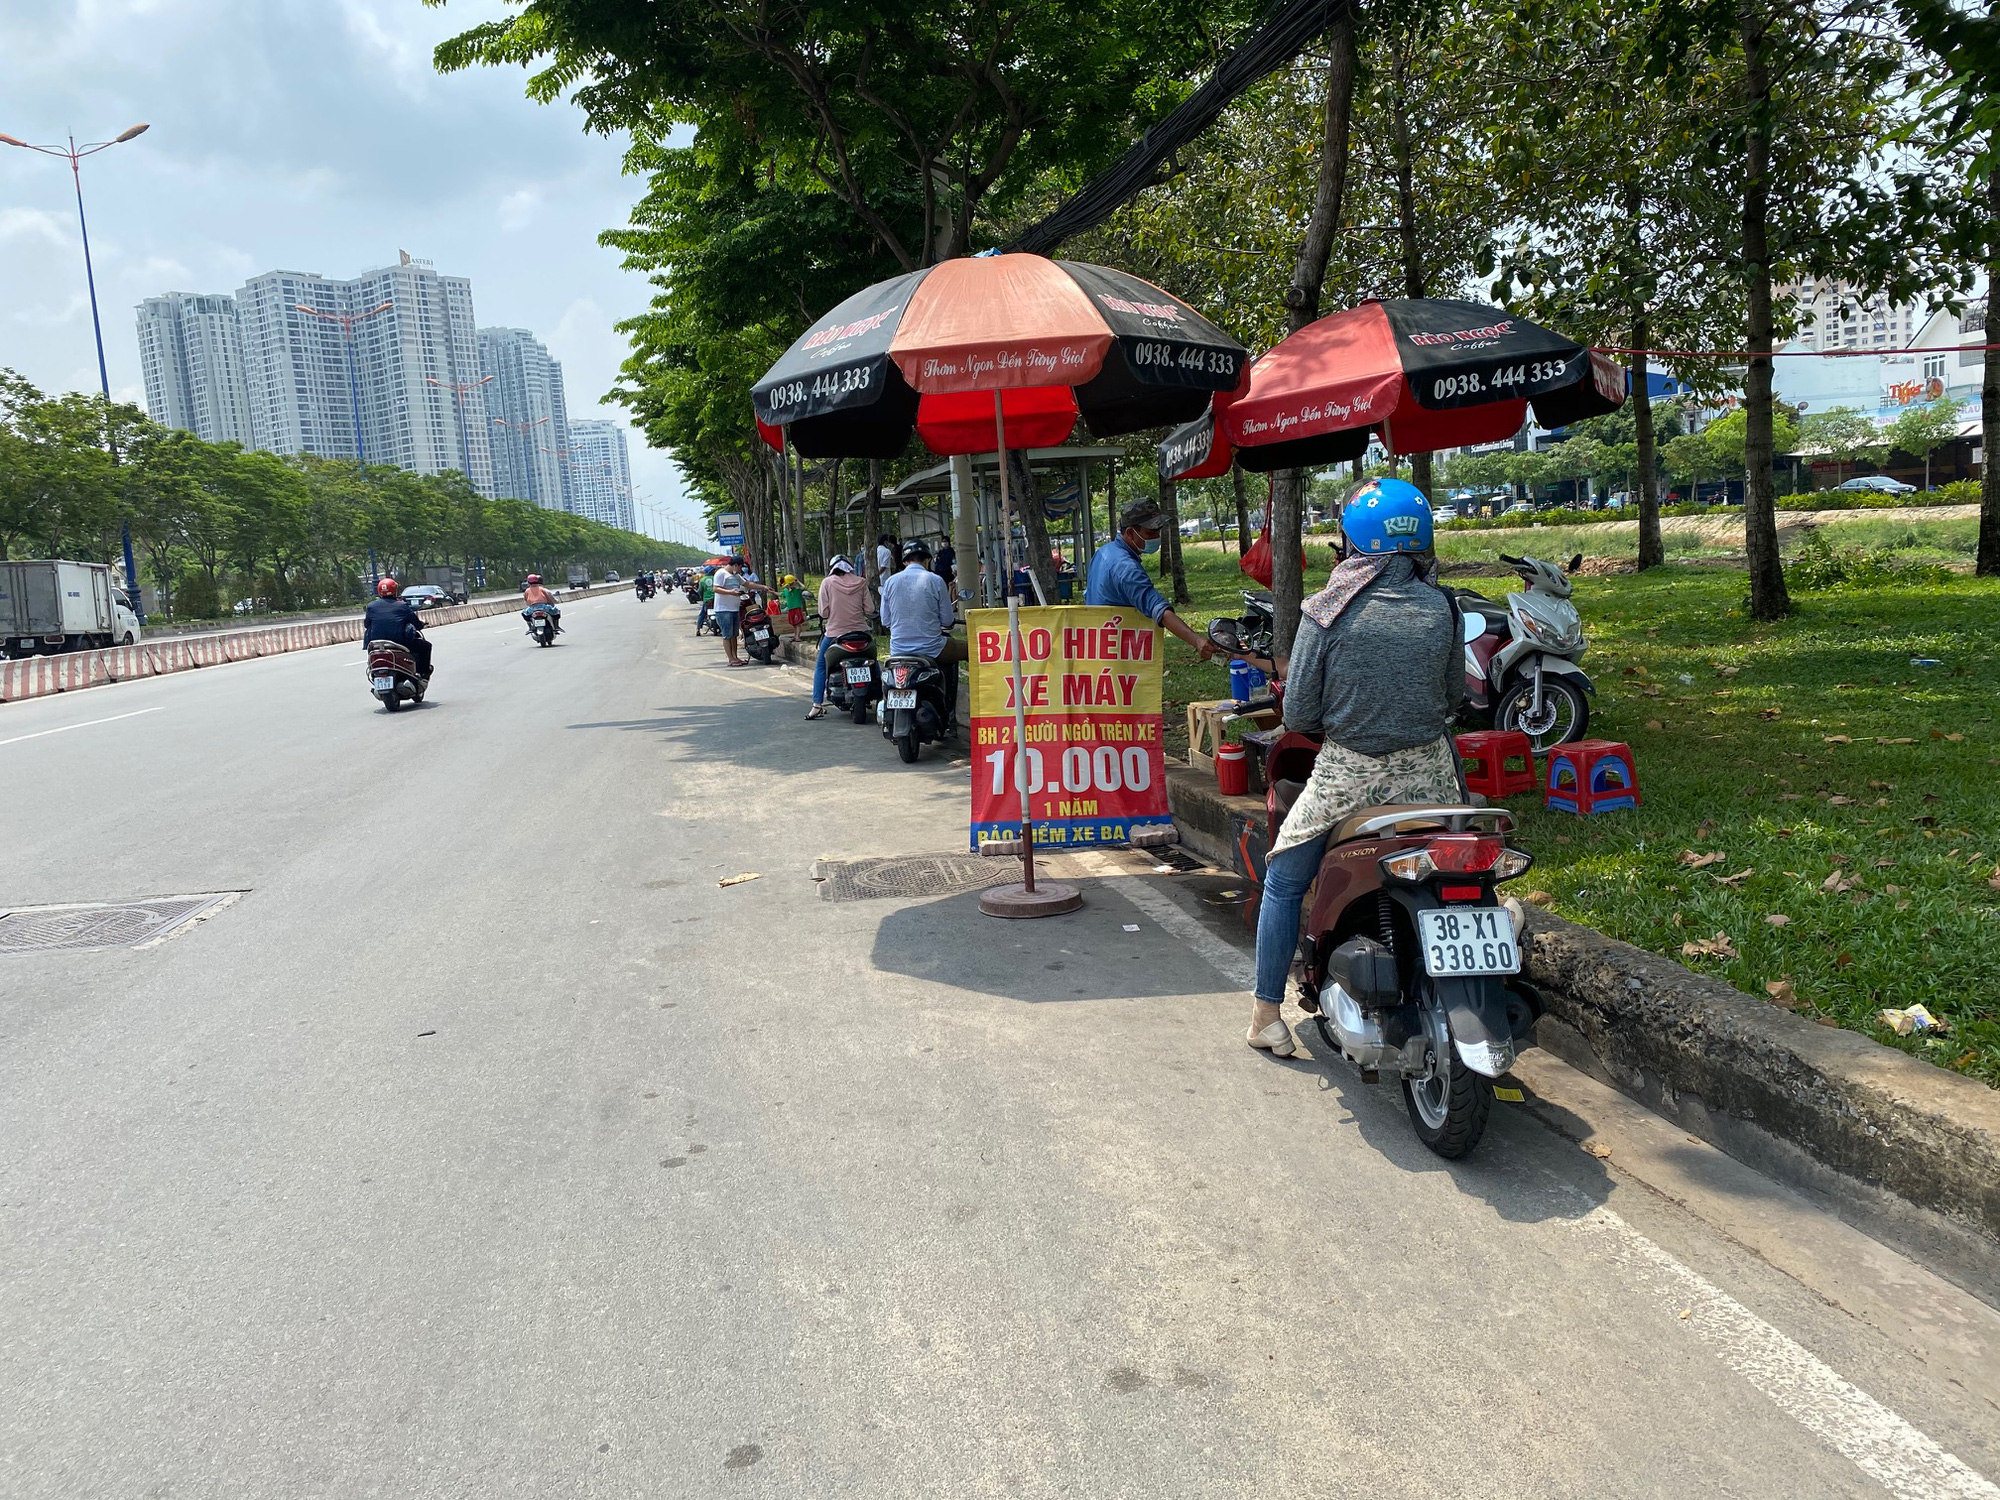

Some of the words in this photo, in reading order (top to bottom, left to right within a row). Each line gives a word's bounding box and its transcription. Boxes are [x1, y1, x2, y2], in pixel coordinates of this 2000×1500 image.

[1408, 332, 1455, 346] BẢO
[1453, 322, 1517, 341] NGỌC
[923, 359, 957, 378] Thơm
[960, 354, 994, 380] Ngon
[997, 350, 1023, 369] Đến
[1026, 348, 1057, 373] Từng
[1060, 346, 1087, 368] Giọt
[1135, 342, 1175, 367] 0938.
[1178, 347, 1206, 371] 444
[1208, 352, 1234, 375] 333
[770, 381, 808, 410] 0938.
[811, 371, 839, 398] 444
[841, 366, 870, 392] 333
[1433, 373, 1486, 400] 0938.
[1491, 364, 1525, 388] 444
[1531, 359, 1567, 382] 333
[1889, 380, 1924, 405] Tiger
[1242, 419, 1268, 435] Thơm
[1270, 412, 1299, 433] Ngon
[1300, 405, 1321, 422] Đến
[1324, 401, 1351, 421] Từng
[1352, 395, 1374, 413] Giọt
[1062, 615, 1155, 661] HIỂM
[1004, 673, 1050, 708] XE
[1061, 667, 1139, 707] MÁY
[977, 727, 998, 745] BH
[1002, 727, 1010, 744] 2
[1013, 720, 1057, 743] GƯỜI
[1062, 717, 1096, 742] NGỒI
[1100, 721, 1133, 742] TRÊN
[1137, 724, 1156, 741] XE
[985, 746, 1151, 795] 10.000
[1044, 801, 1052, 817] 1
[1059, 798, 1098, 816] NĂM
[1072, 827, 1095, 841] XE
[1101, 825, 1126, 841] BA
[1340, 847, 1378, 861] VISION
[1433, 913, 1498, 941] 38-X1
[1431, 942, 1513, 971] 338.60
